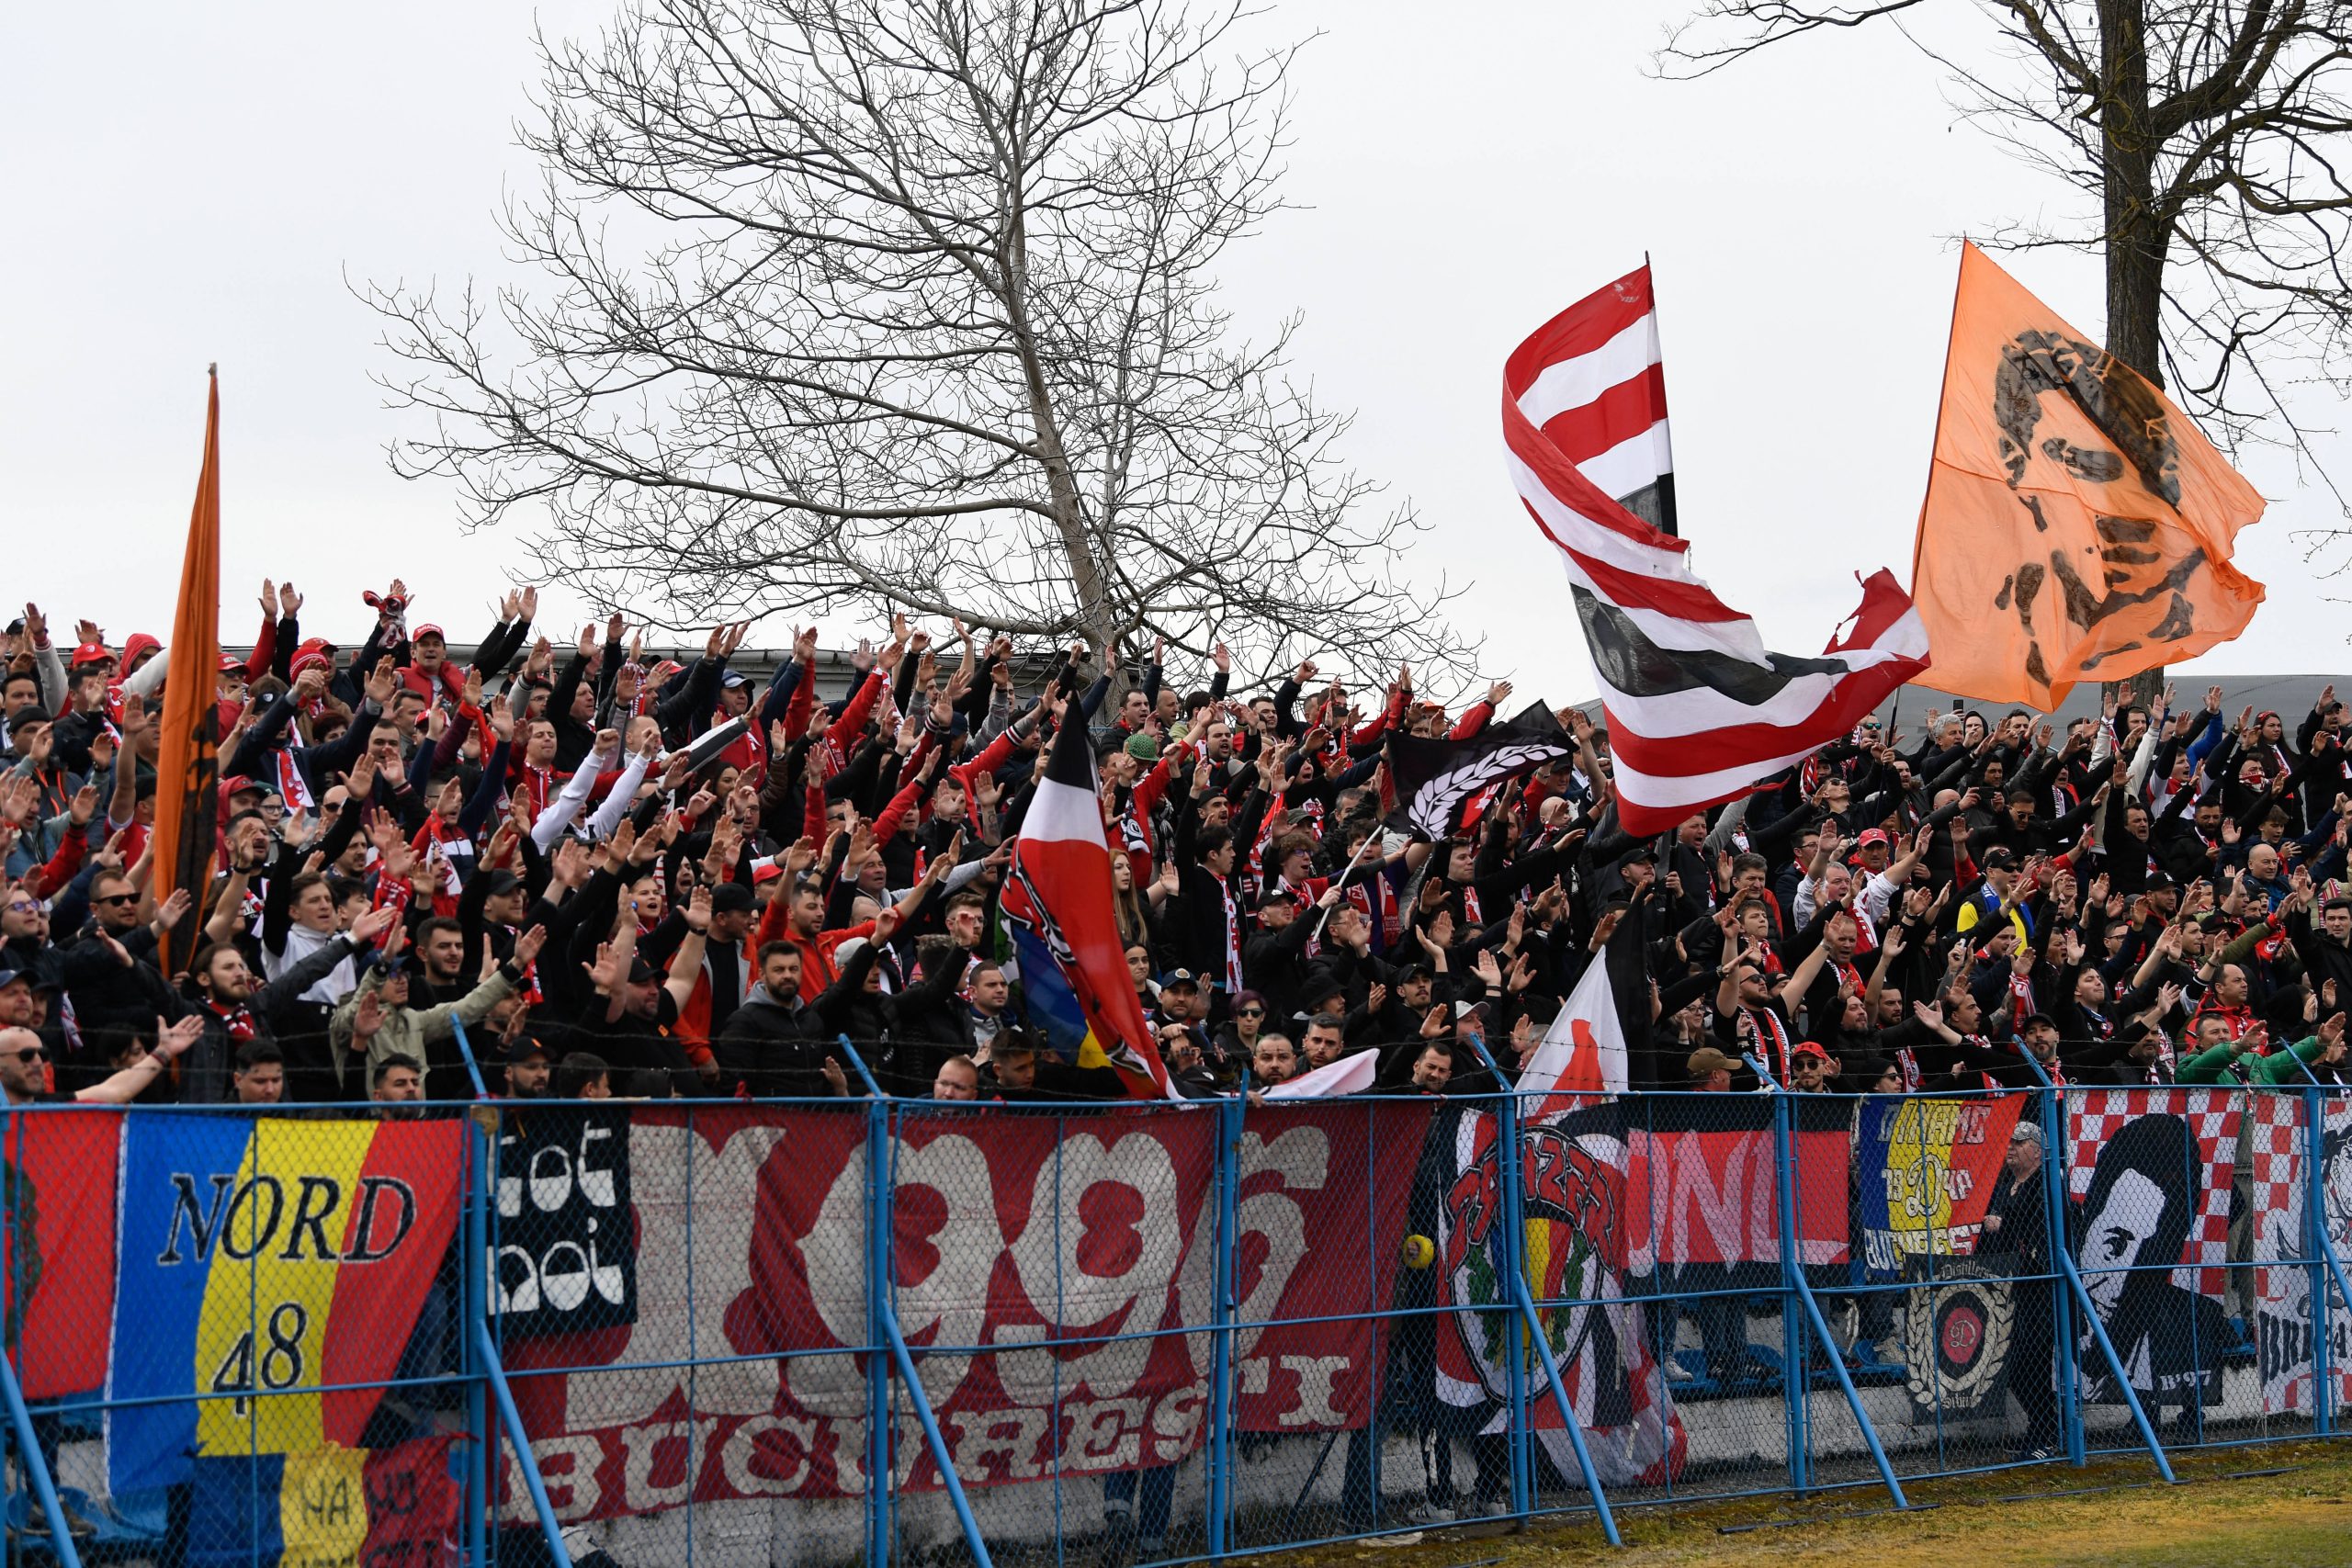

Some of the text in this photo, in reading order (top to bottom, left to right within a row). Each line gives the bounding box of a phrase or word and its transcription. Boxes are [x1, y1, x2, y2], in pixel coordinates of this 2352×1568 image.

[158, 1173, 418, 1264] NORD
[564, 1121, 1331, 1434] 1996
[212, 1301, 309, 1417] 48
